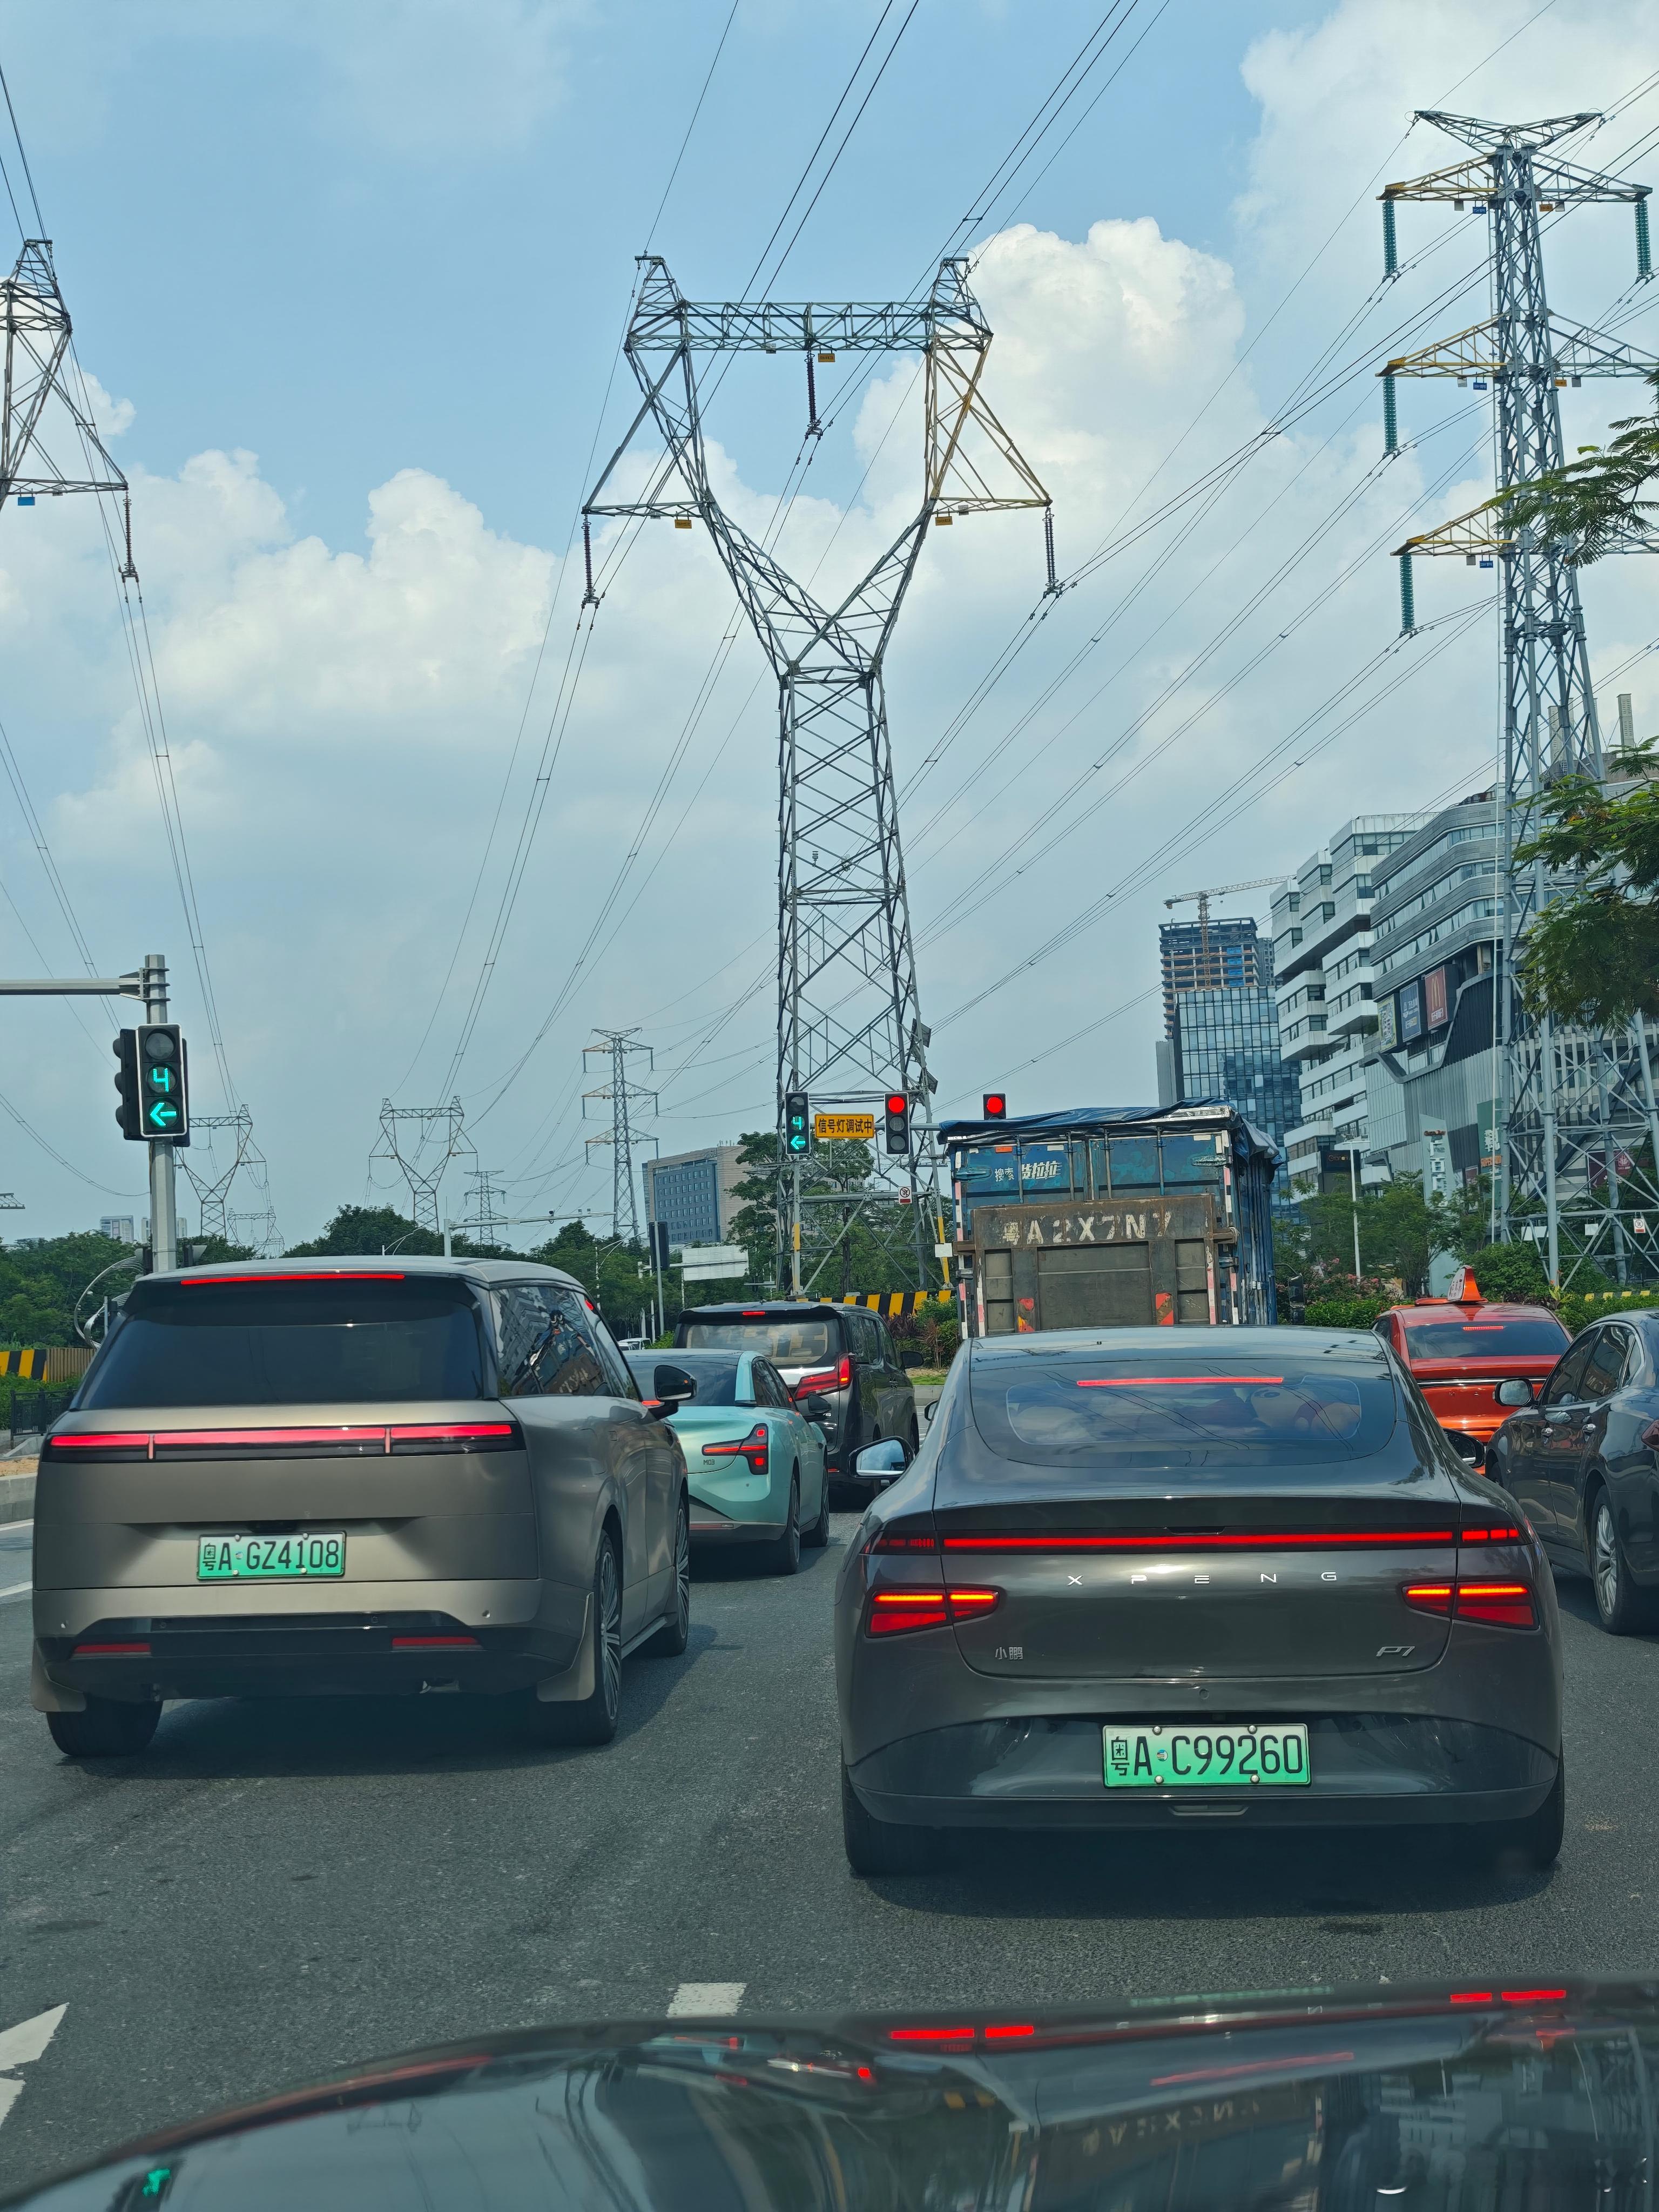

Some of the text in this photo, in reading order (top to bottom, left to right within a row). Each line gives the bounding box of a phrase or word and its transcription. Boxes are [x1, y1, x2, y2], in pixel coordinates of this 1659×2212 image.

[153, 1068, 169, 1092] 4
[792, 1116, 802, 1130] 4
[818, 1118, 872, 1134] 信号灯调试中
[995, 1167, 1014, 1182] 搜索
[995, 1646, 1024, 1660] 小鹏
[1376, 1645, 1415, 1657] P7
